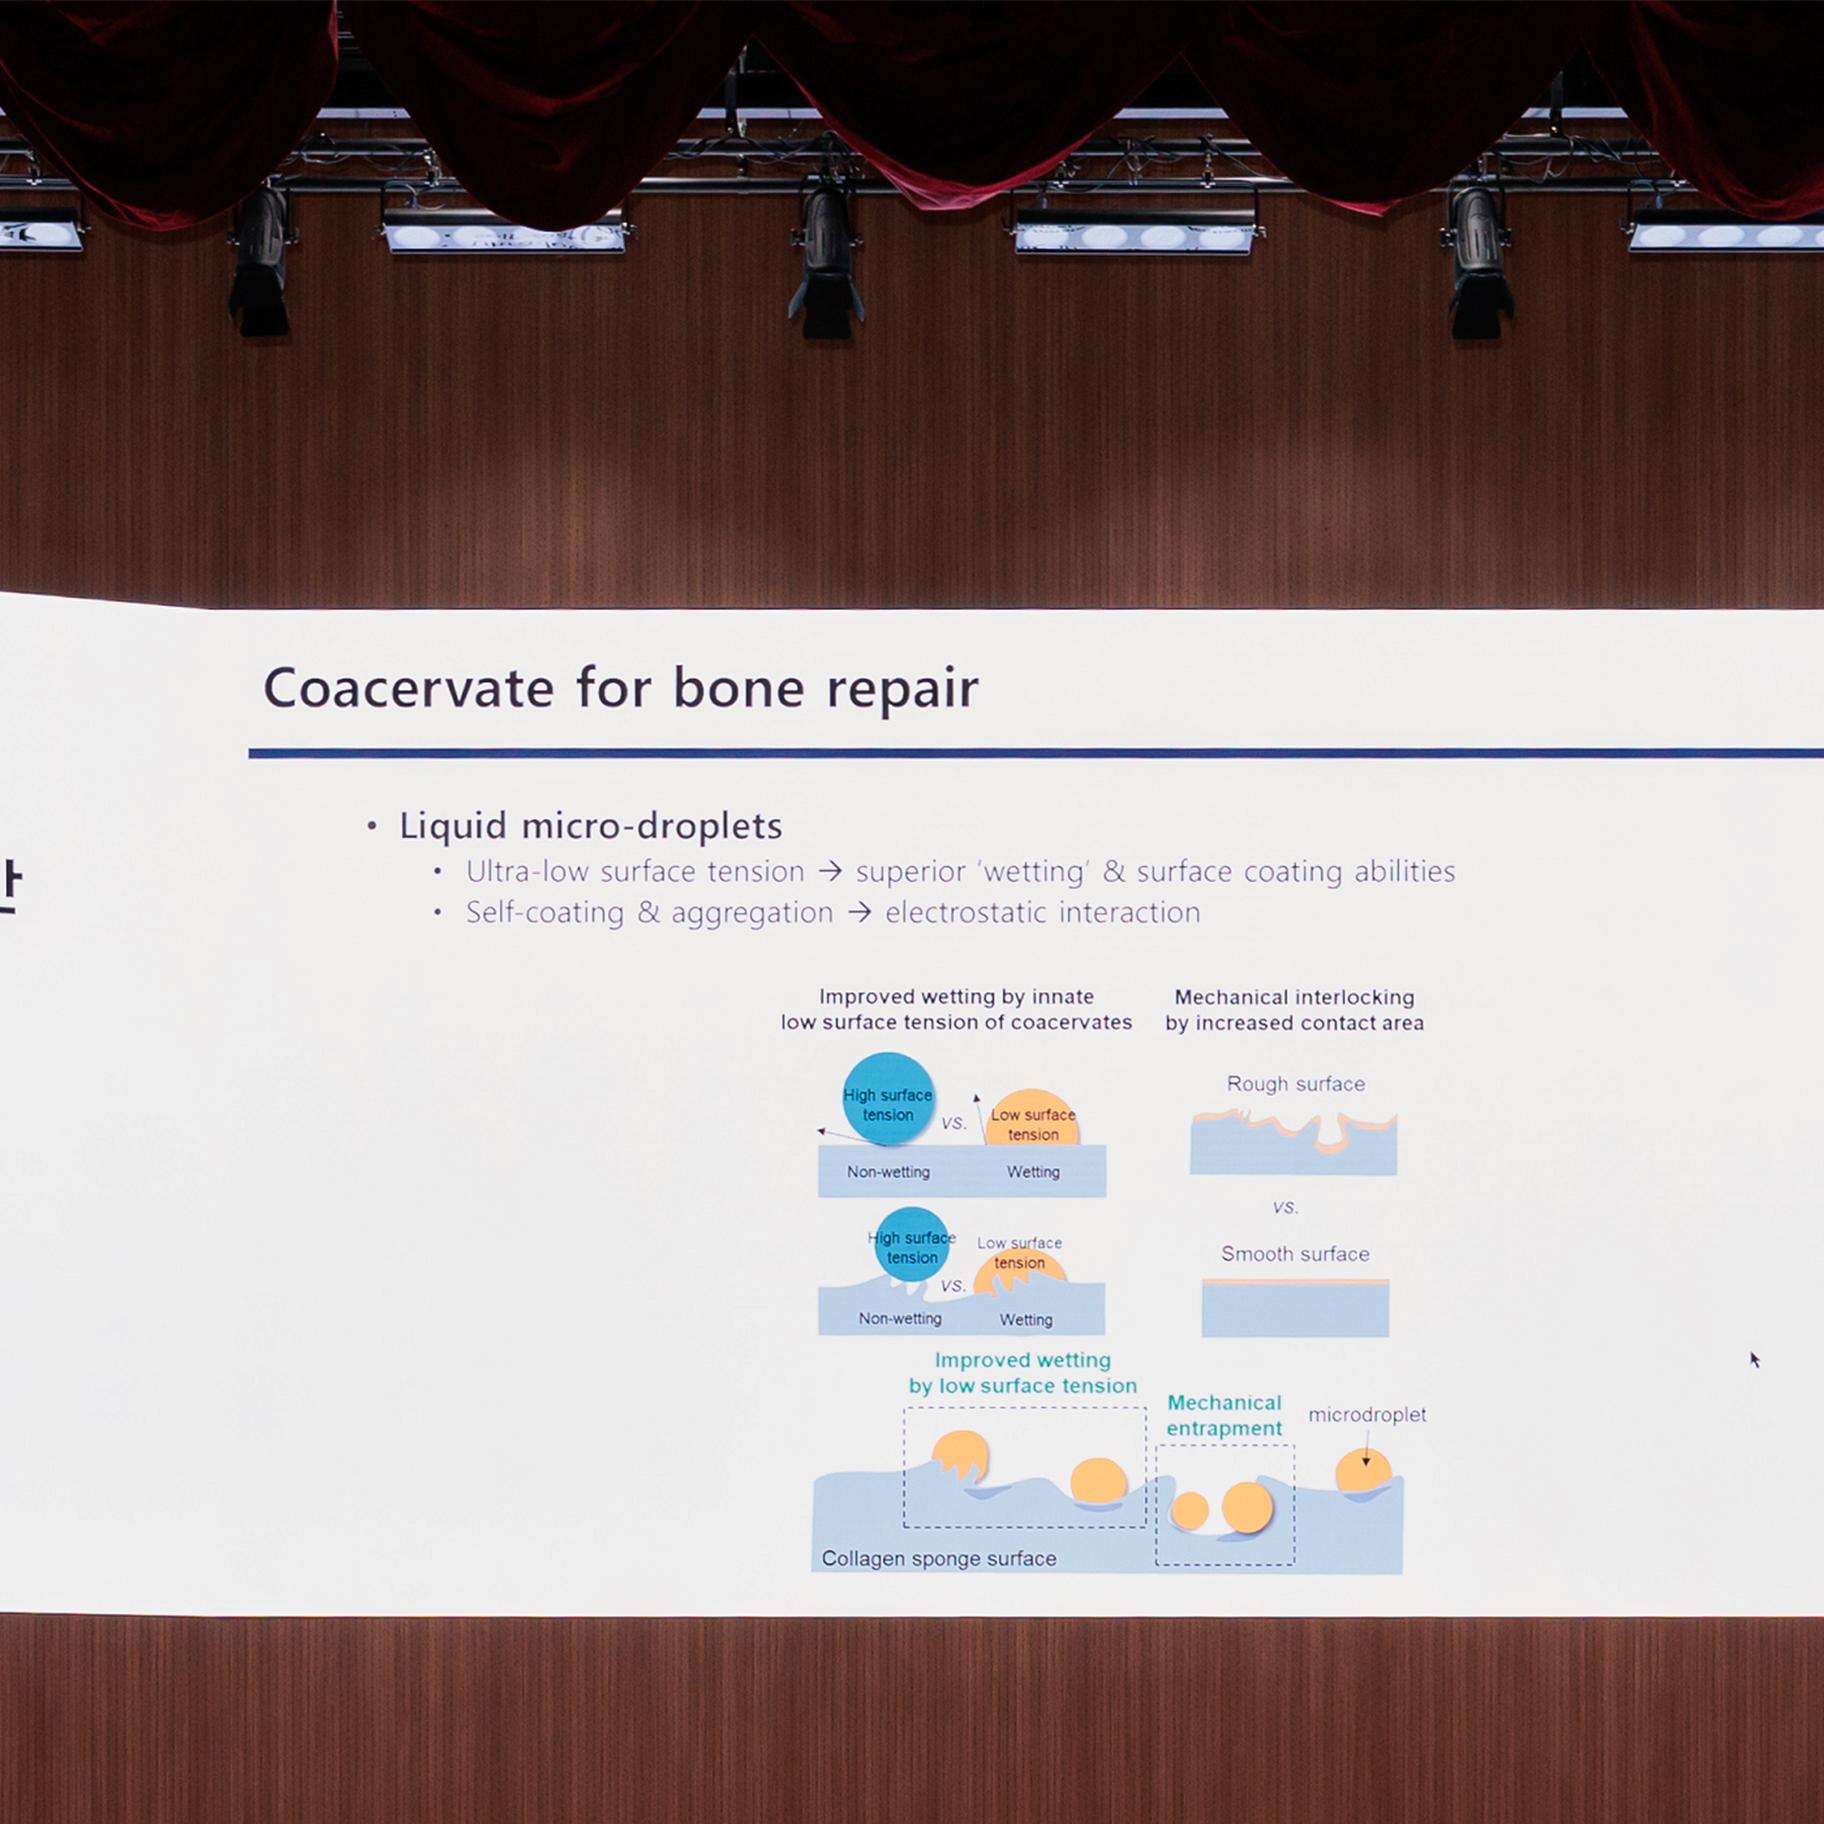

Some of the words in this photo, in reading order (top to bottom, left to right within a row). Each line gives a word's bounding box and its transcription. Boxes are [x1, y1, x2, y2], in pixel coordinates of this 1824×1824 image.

[263, 665, 555, 709] Coacervate
[575, 663, 653, 709] for
[674, 663, 805, 709] bone
[828, 663, 980, 722] repair
[400, 809, 507, 849] Liquid
[522, 808, 783, 849] micro-droplets
[467, 858, 590, 883] Ultra-low
[600, 857, 696, 883] surface
[706, 858, 805, 884] tension
[856, 858, 967, 889] superior
[1103, 858, 1127, 883] &
[1137, 857, 1233, 883] surface
[1244, 858, 1342, 890] coating
[1354, 857, 1456, 884] abilities
[466, 898, 624, 931] Self-coating
[637, 899, 662, 924] &
[671, 899, 833, 931] aggregation
[885, 898, 1047, 924] electrostatic
[1059, 899, 1201, 924] interaction
[819, 987, 916, 1009] Improved
[920, 987, 996, 1009] wetting
[1001, 987, 1026, 1009] by
[1032, 987, 1095, 1006] innate
[1175, 988, 1289, 1006] Mechanical
[1295, 988, 1415, 1010] interlocking
[781, 1013, 818, 1031] low
[822, 1013, 898, 1031] surface
[903, 1013, 979, 1031] tension
[984, 1013, 1006, 1031] of
[1010, 1014, 1134, 1031] coacervates
[1165, 1013, 1190, 1035] by
[1196, 1013, 1294, 1032] increased
[1300, 1014, 1378, 1032] contact
[1381, 1017, 1425, 1032] area
[1227, 1074, 1289, 1097] Rough
[1295, 1074, 1366, 1093] surface
[843, 1089, 876, 1104] High
[880, 1088, 933, 1102] surface
[863, 1108, 914, 1122] tension
[991, 1109, 1021, 1121] Low
[1024, 1108, 1076, 1121] surface
[1008, 1128, 1059, 1141] tension
[847, 1164, 931, 1182] Non-wetting
[1006, 1164, 1061, 1182] Wetting
[868, 1231, 900, 1246] High
[905, 1231, 957, 1245] surface
[977, 1236, 1007, 1249] Low
[1011, 1236, 1063, 1249] surface
[887, 1251, 938, 1264] tension
[994, 1256, 1045, 1269] tension
[1221, 1244, 1294, 1263] Smooth
[1300, 1244, 1371, 1263] surface
[858, 1311, 943, 1329] Non-wetting
[999, 1312, 1054, 1330] Wetting
[934, 1351, 1032, 1373] Improved
[1036, 1351, 1112, 1374] wetting
[908, 1376, 934, 1399] by
[939, 1376, 976, 1395] low
[979, 1376, 1056, 1395] surface
[1061, 1376, 1138, 1395] tension
[1167, 1393, 1282, 1412] Mechanical
[1308, 1405, 1428, 1428] microdroplet
[1166, 1419, 1284, 1441] entrapment
[822, 1548, 906, 1573] Collagen
[911, 1553, 982, 1574] sponge
[986, 1549, 1058, 1568] surface
